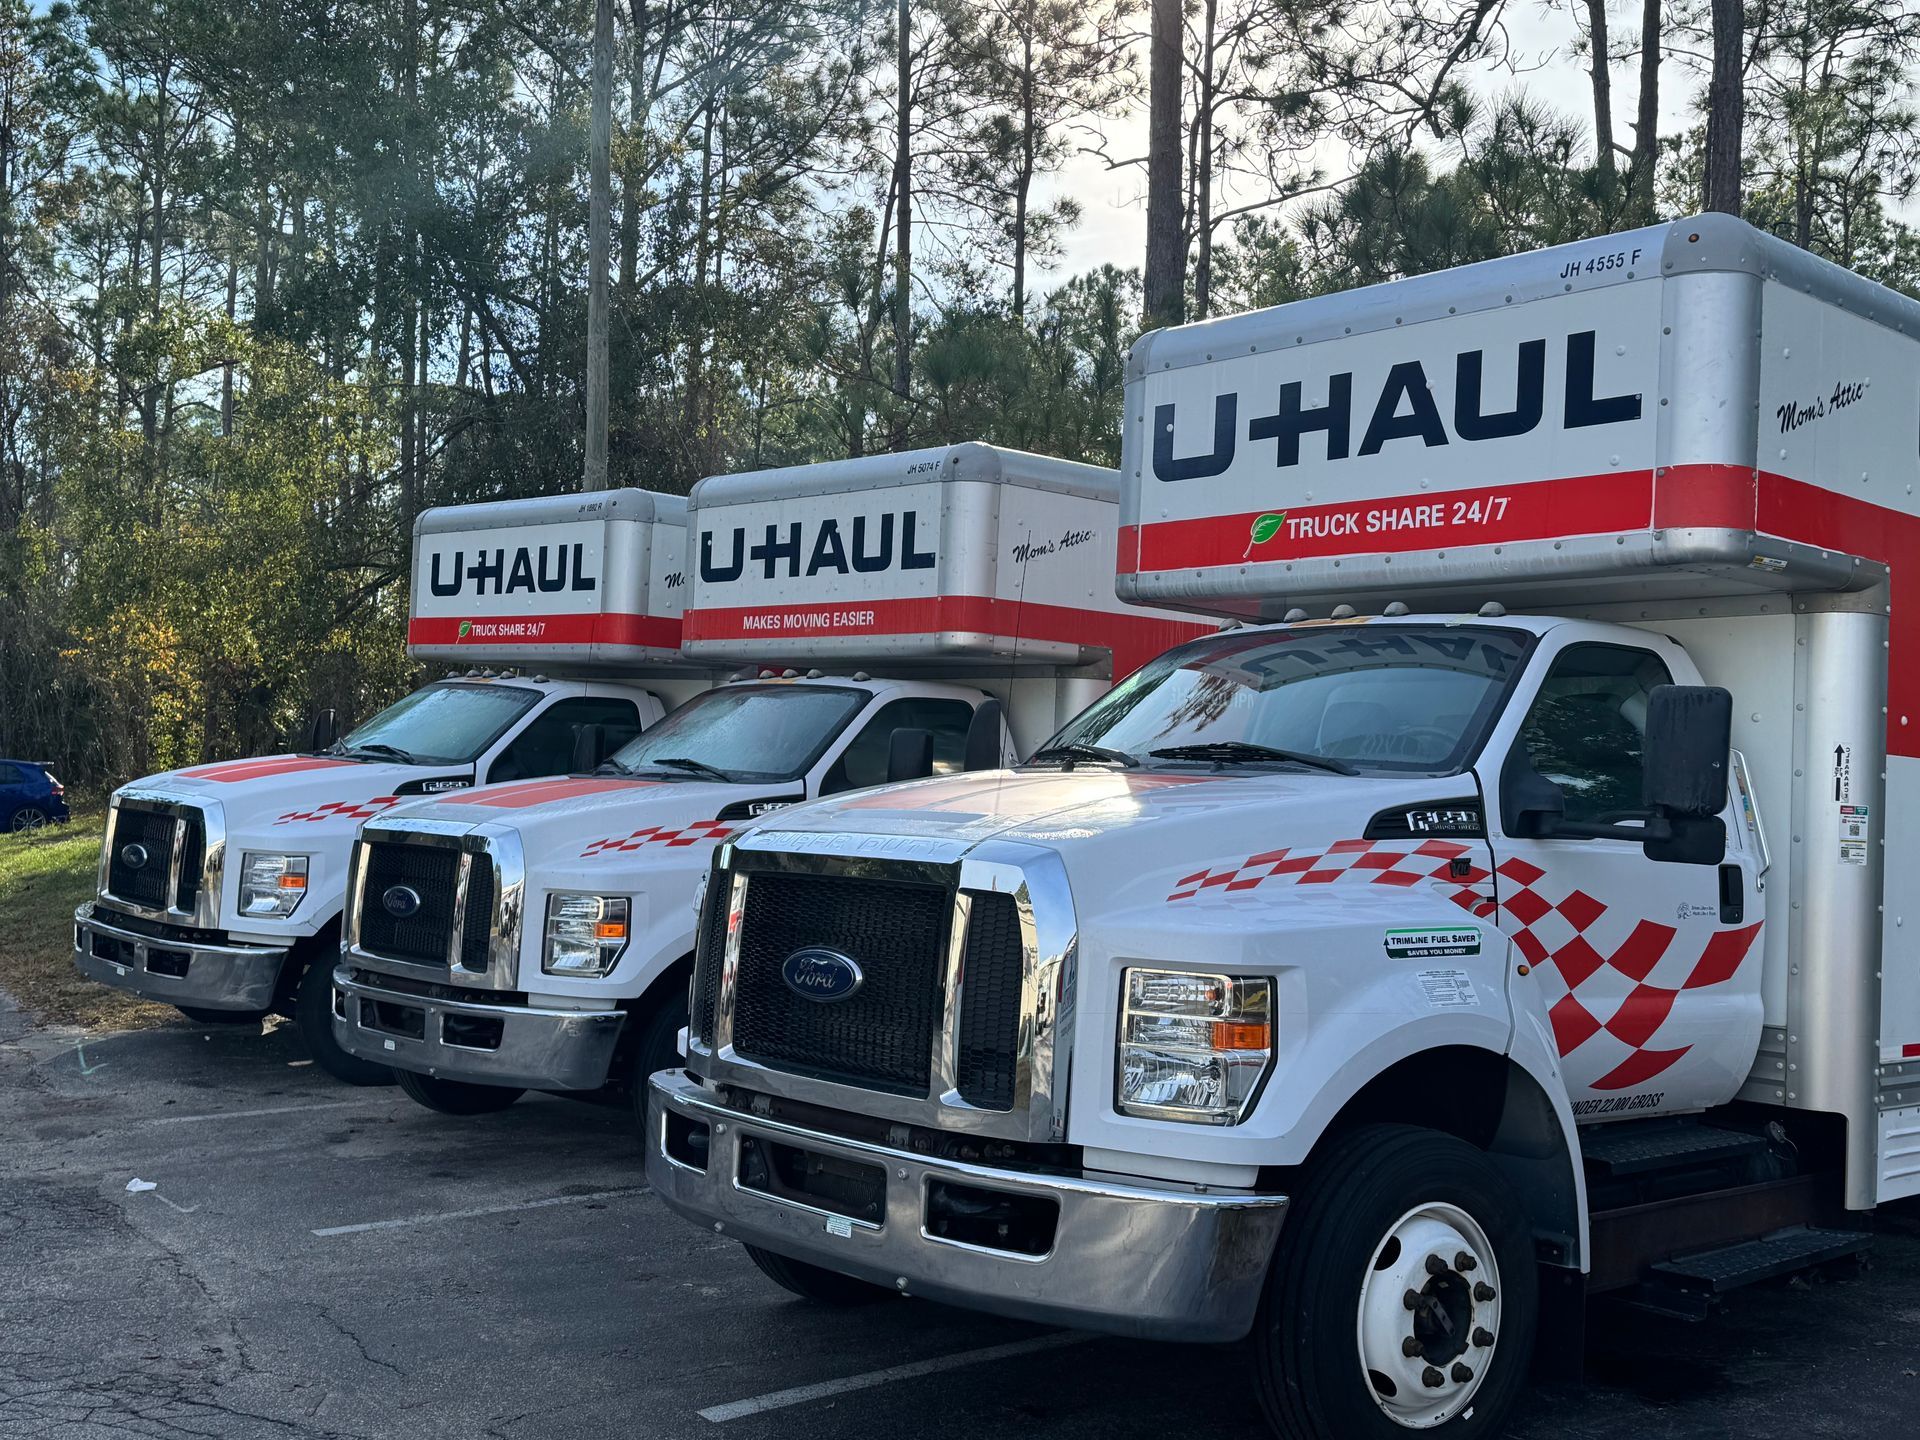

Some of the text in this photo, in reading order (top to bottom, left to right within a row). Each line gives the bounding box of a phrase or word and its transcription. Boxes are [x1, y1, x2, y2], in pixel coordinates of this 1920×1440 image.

[1560, 249, 1642, 279] JH 4555 F
[1152, 330, 1642, 482] U-HAUL
[1777, 381, 1864, 434] Mom's Attic
[907, 460, 941, 474] JH 5074 F
[1286, 495, 1510, 540] TRUCK SHARE 24/7
[700, 511, 936, 583] U-HAUL
[1012, 530, 1092, 564] Mom's Attic
[430, 543, 596, 597] U-HAUL
[472, 621, 546, 637] TRUCK SHARE 24/7
[743, 610, 875, 630] MAKES MOVING EASIER
[758, 831, 954, 856] SUPER DUTY
[1391, 936, 1428, 945] TRIMLINE
[1431, 935, 1451, 944] FUEL
[1407, 949, 1429, 957] SAVES
[794, 957, 837, 988] Ford
[1628, 1092, 1665, 1110] GROSS
